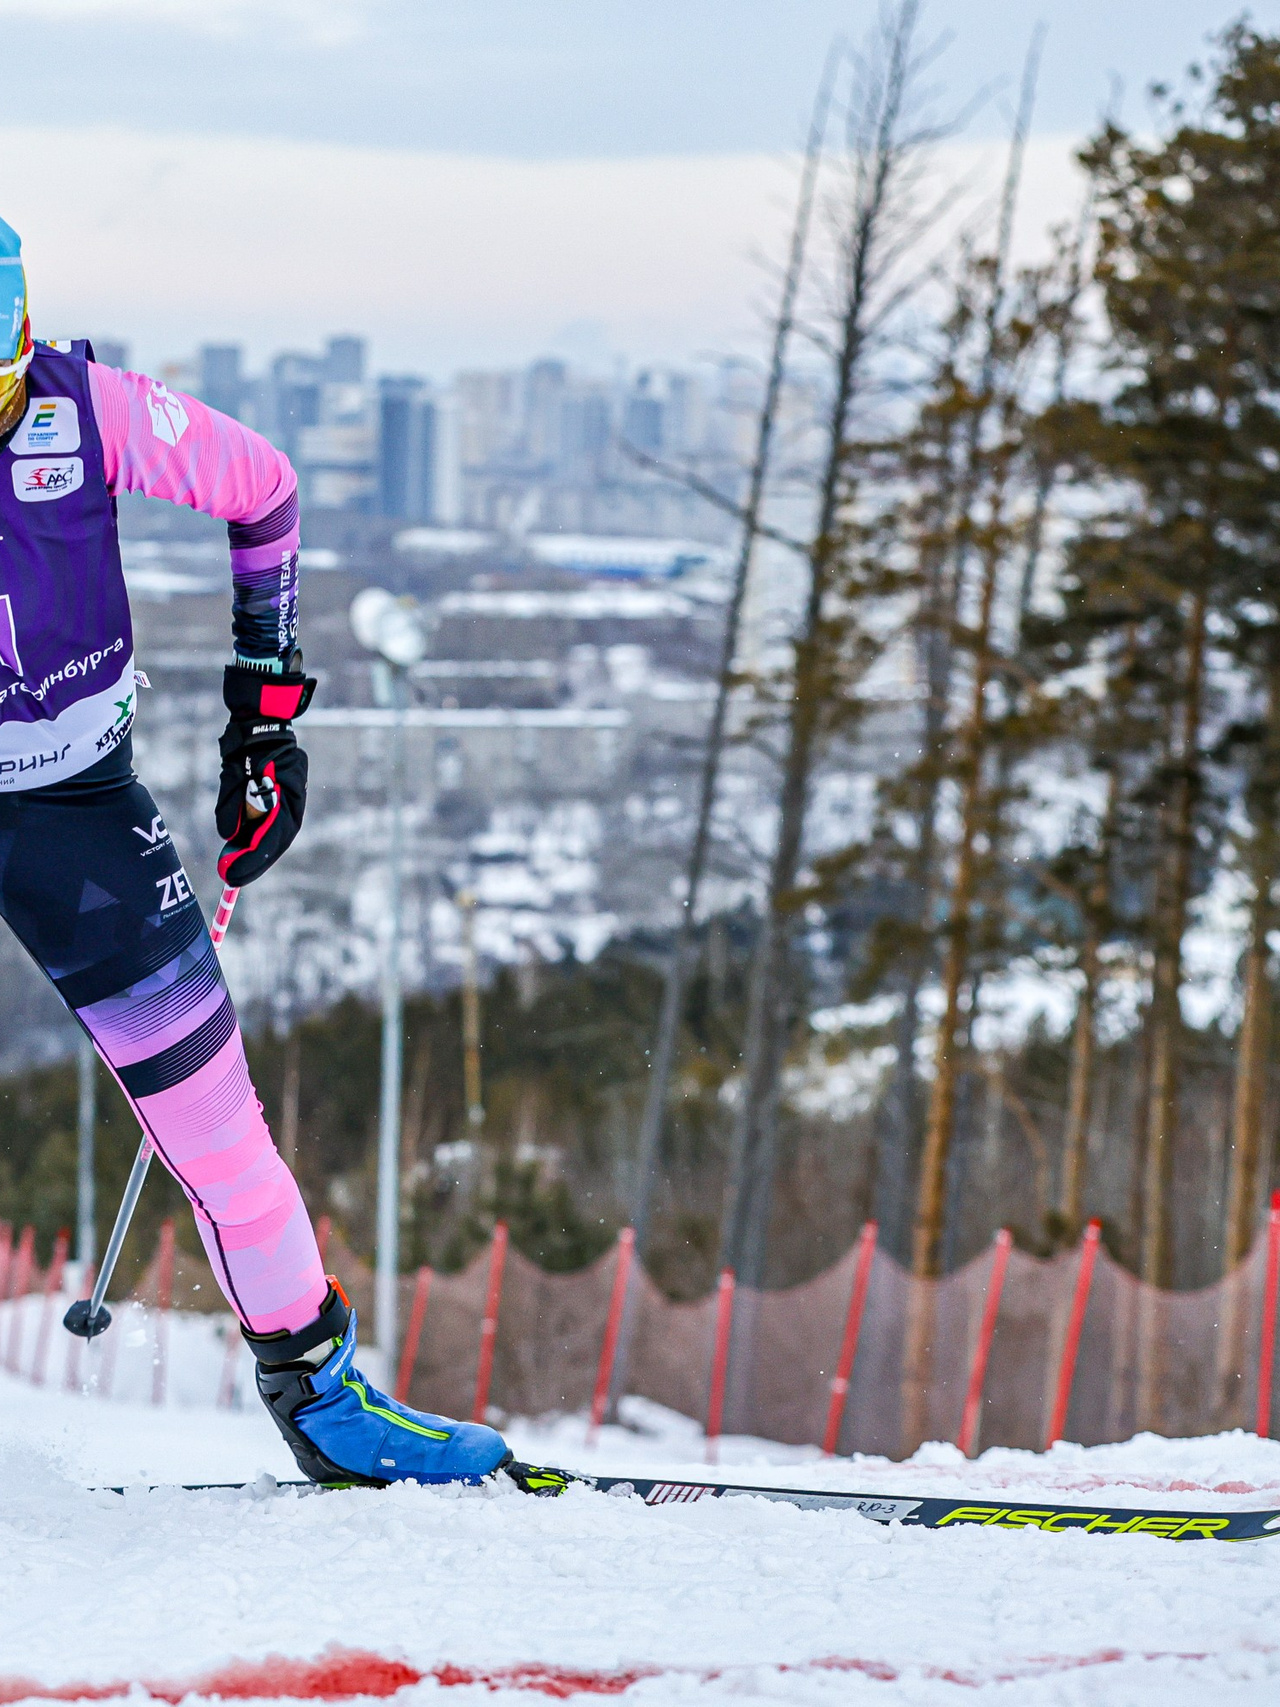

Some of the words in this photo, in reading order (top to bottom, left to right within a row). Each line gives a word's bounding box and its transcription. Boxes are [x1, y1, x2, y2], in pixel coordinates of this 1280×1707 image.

[281, 550, 292, 588] TEAM
[95, 725, 115, 753] ХЭТ
[934, 1506, 1231, 1539] FISCHER
